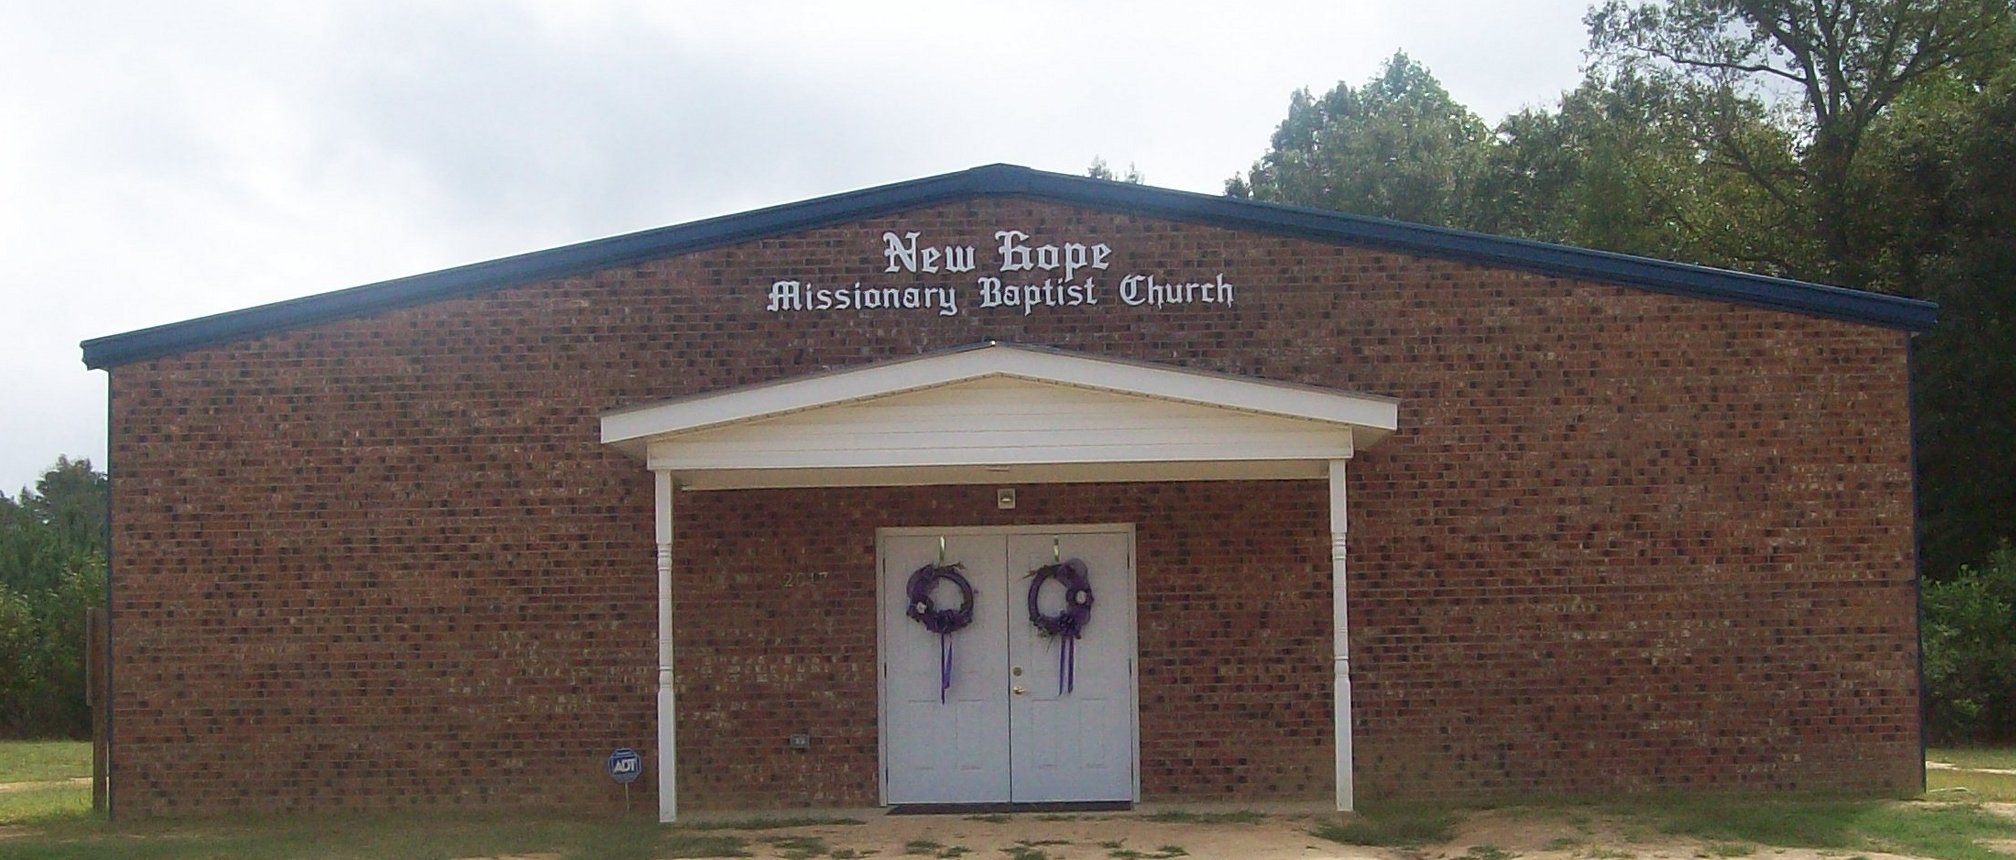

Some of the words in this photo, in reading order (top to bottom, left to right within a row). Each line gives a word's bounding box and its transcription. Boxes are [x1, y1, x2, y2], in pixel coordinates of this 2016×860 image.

[883, 232, 976, 273] New
[995, 231, 1112, 281] Hope
[767, 280, 957, 316] Missionary
[978, 277, 1098, 315] Baptist
[1119, 273, 1234, 309] Church
[613, 758, 636, 773] ADT
